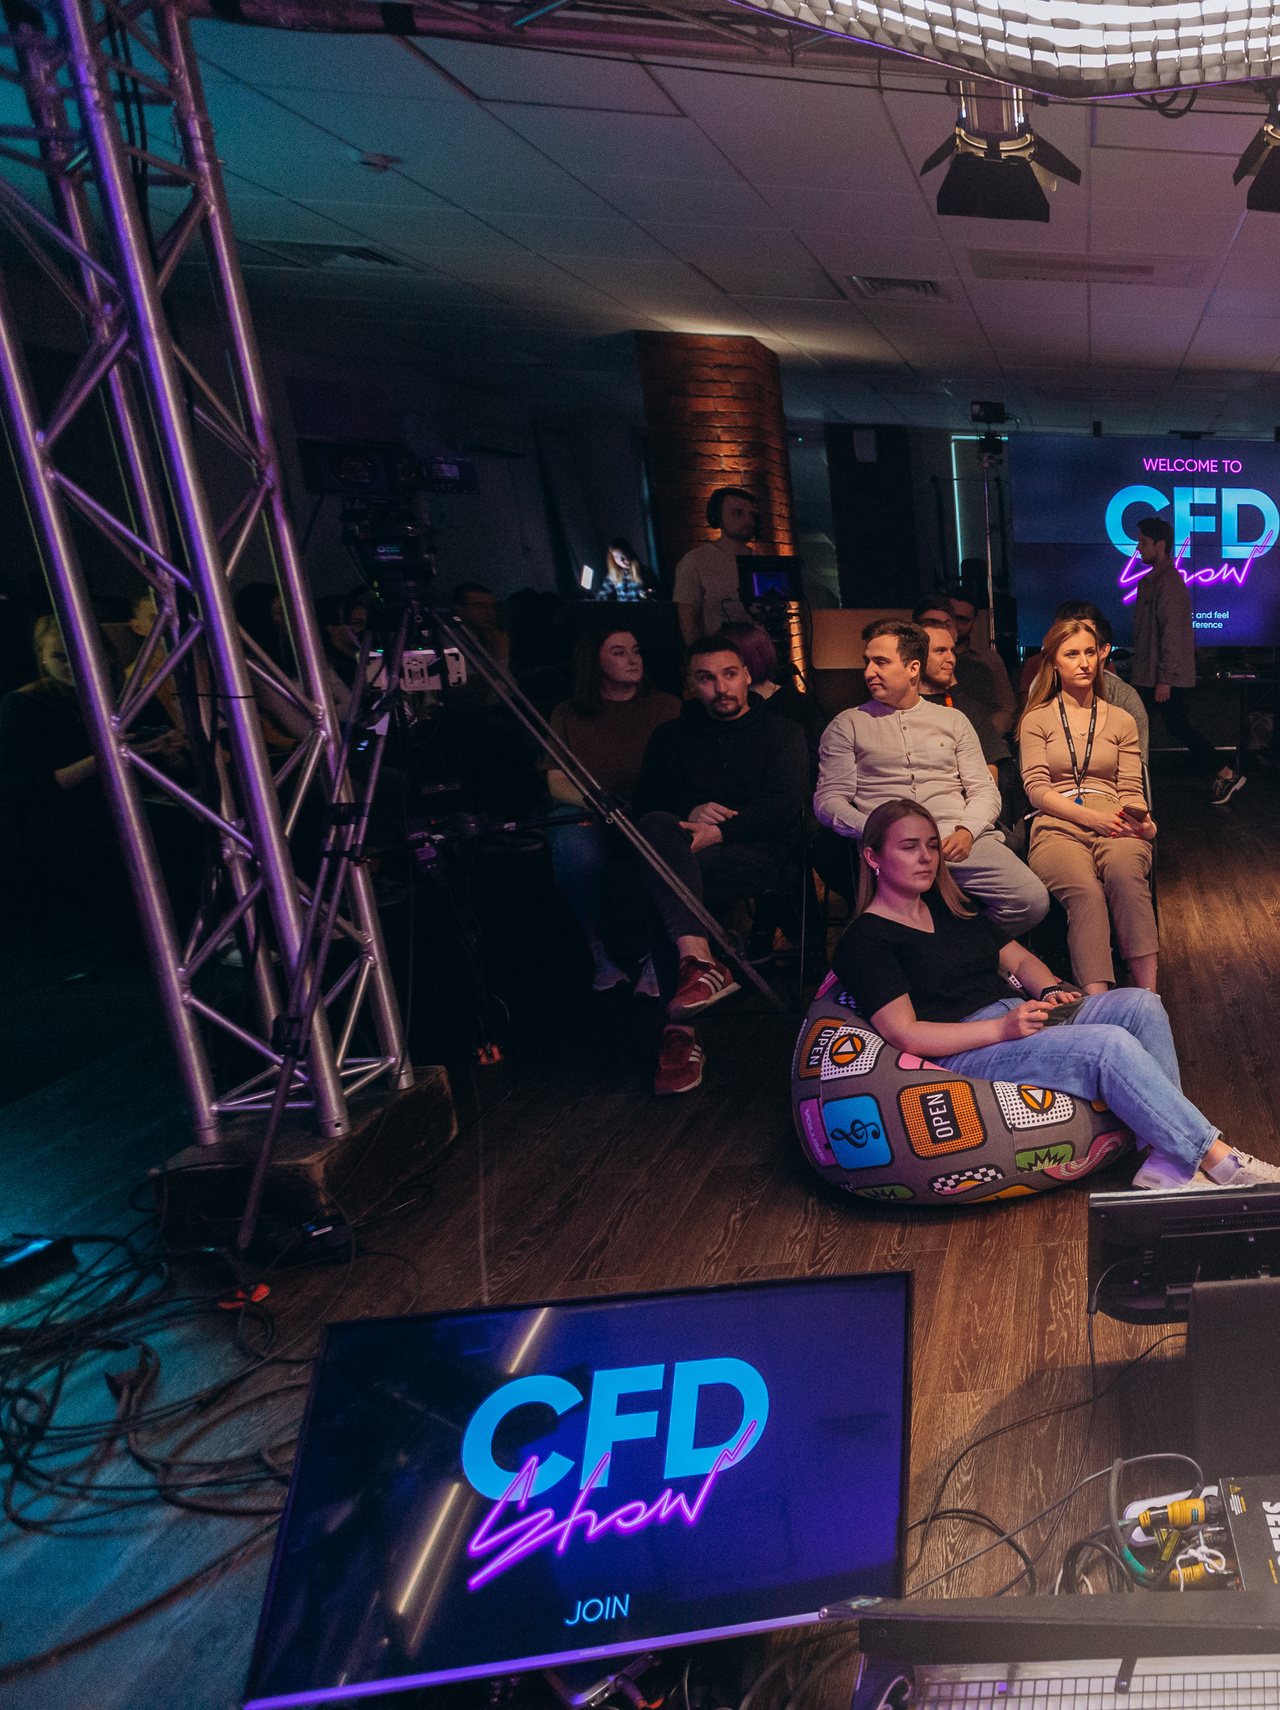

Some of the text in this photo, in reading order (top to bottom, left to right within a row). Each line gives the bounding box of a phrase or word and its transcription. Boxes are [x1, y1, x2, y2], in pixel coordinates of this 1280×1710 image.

[1143, 458, 1243, 474] WELCOME TO
[1105, 484, 1280, 559] CFD
[1195, 611, 1213, 619] and
[1214, 610, 1229, 619] feel
[809, 1029, 835, 1067] OPEN
[927, 1093, 954, 1139] OPEN
[461, 1356, 770, 1503] CFD
[468, 1419, 758, 1592] Show
[564, 1593, 631, 1627] JOIN
